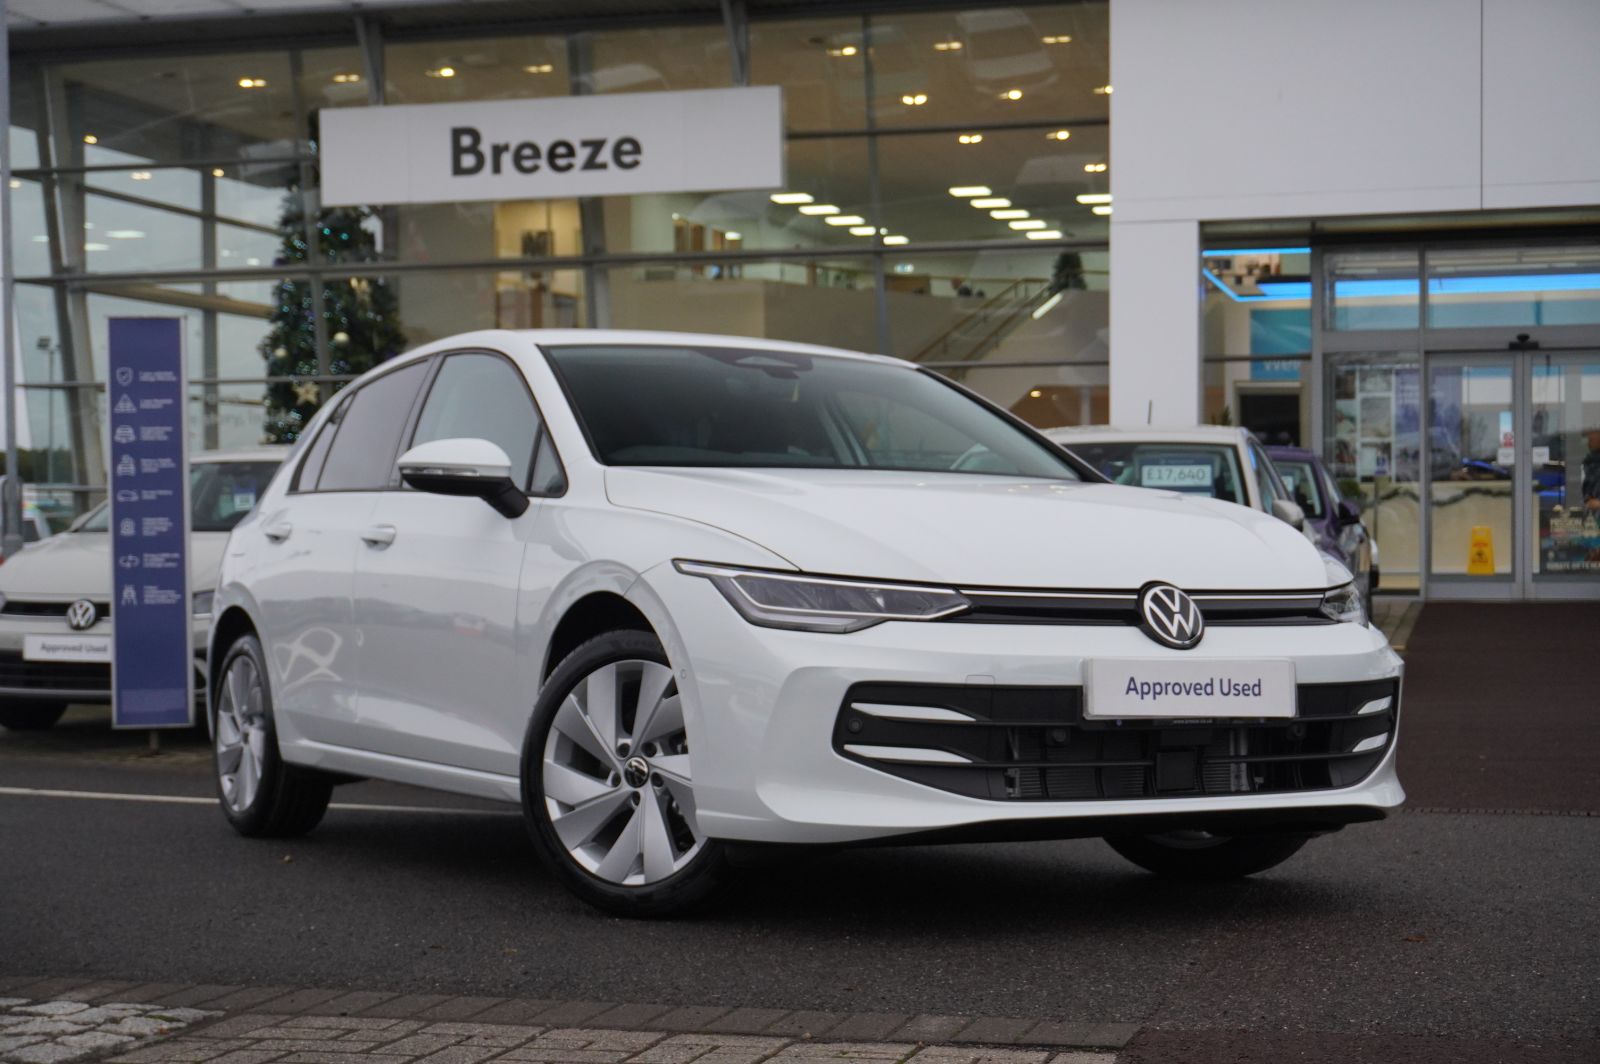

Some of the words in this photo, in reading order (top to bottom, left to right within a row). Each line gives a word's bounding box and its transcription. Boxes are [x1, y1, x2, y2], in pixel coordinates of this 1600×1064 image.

[450, 126, 643, 177] Breeze
[1146, 468, 1206, 483] £17,640
[1125, 676, 1215, 701] Approved
[1219, 677, 1262, 697] Used
